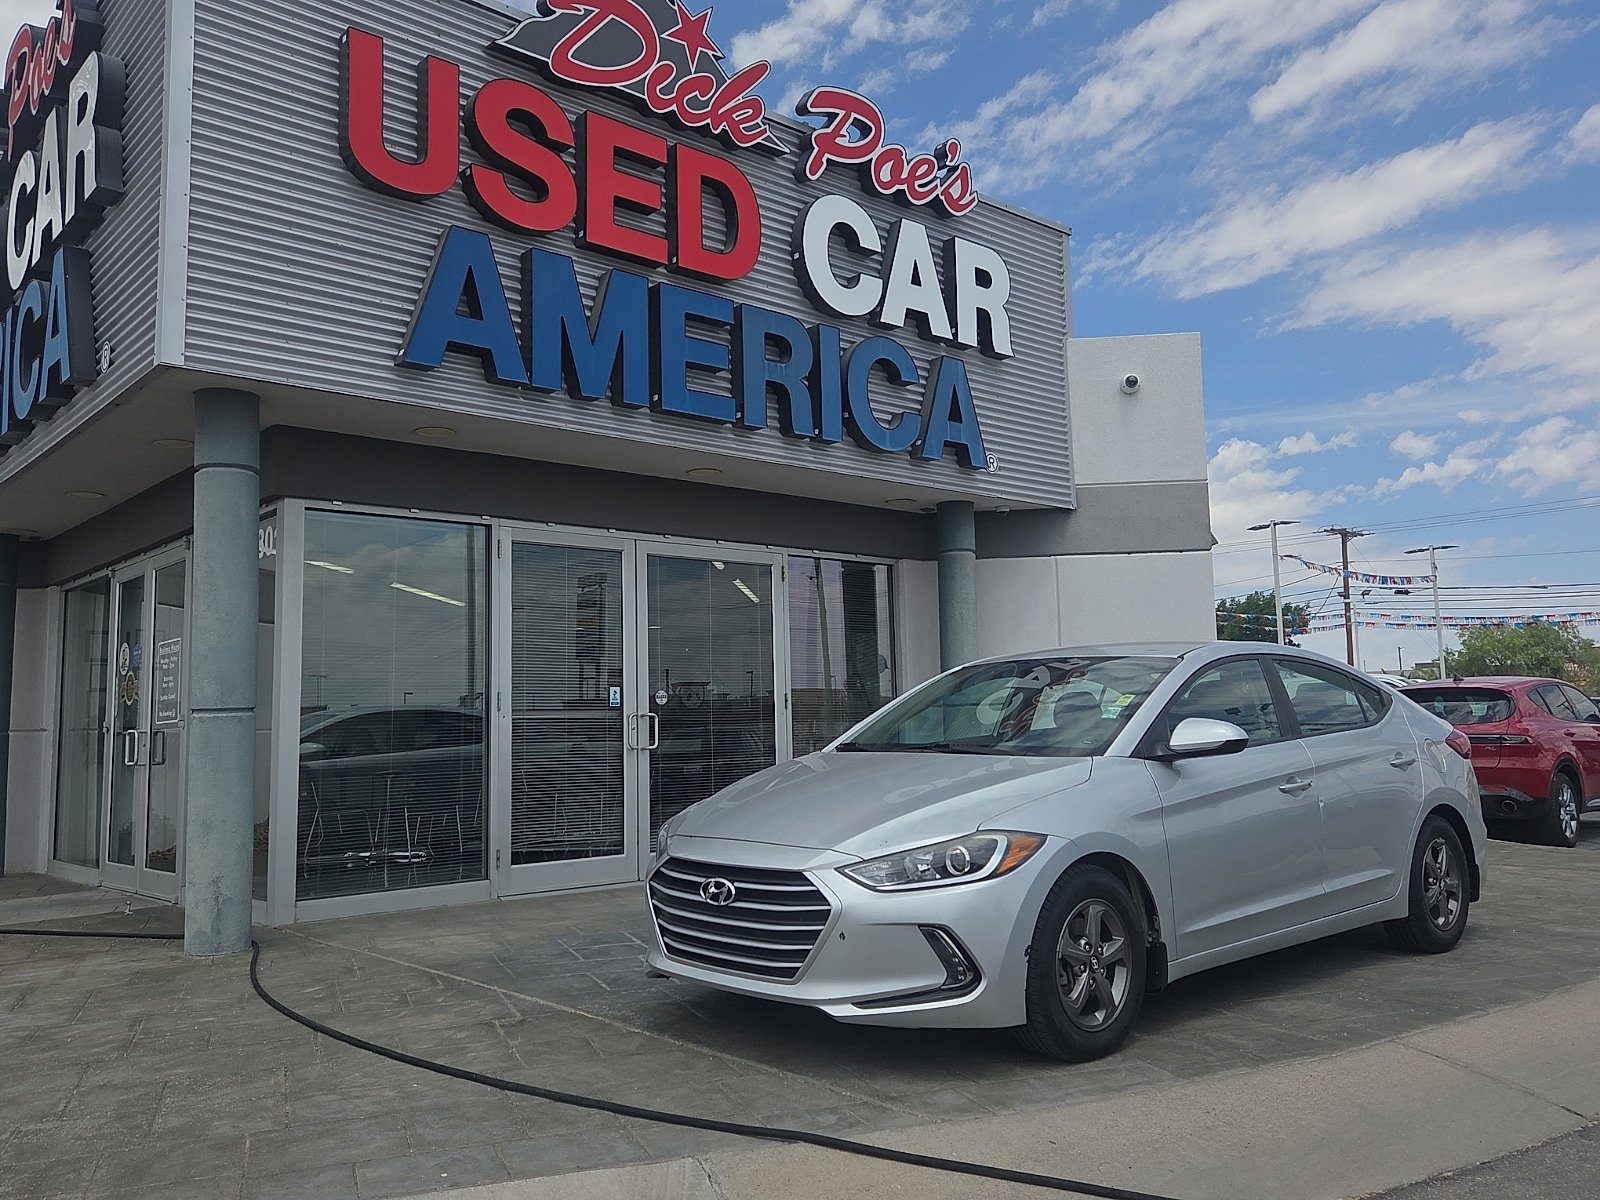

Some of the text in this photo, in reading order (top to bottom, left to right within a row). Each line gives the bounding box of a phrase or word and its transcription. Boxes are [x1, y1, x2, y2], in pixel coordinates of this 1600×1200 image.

[7, 51, 99, 291] CAR
[345, 26, 1014, 357] USED CAR
[548, 0, 979, 216] Dick Poe's
[0, 244, 71, 435] ICA
[396, 225, 987, 470] AMERICA
